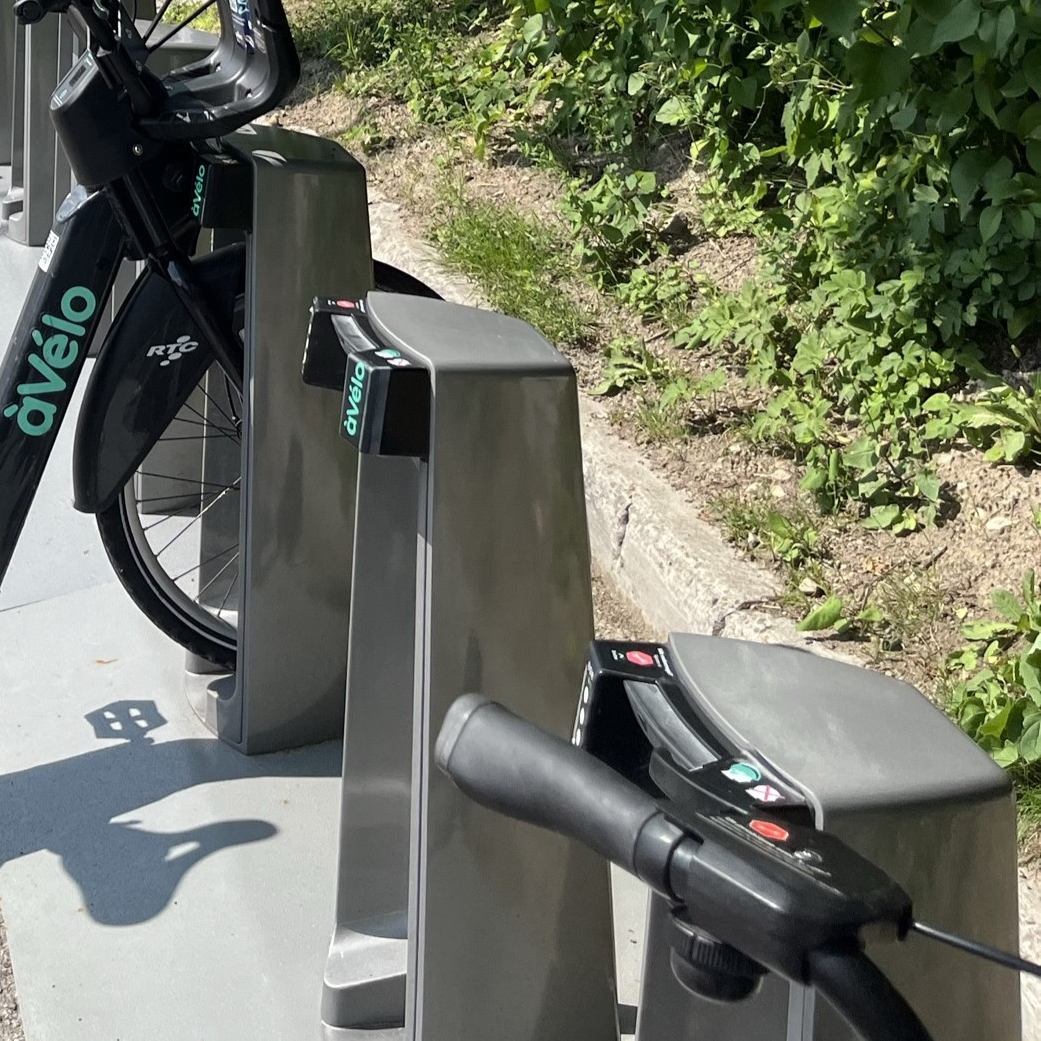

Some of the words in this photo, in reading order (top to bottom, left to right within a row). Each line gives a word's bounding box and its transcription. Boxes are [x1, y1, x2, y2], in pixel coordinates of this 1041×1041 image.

[3, 285, 97, 437] àVélo
[146, 340, 199, 357] RTC
[344, 361, 366, 436] àVélo
